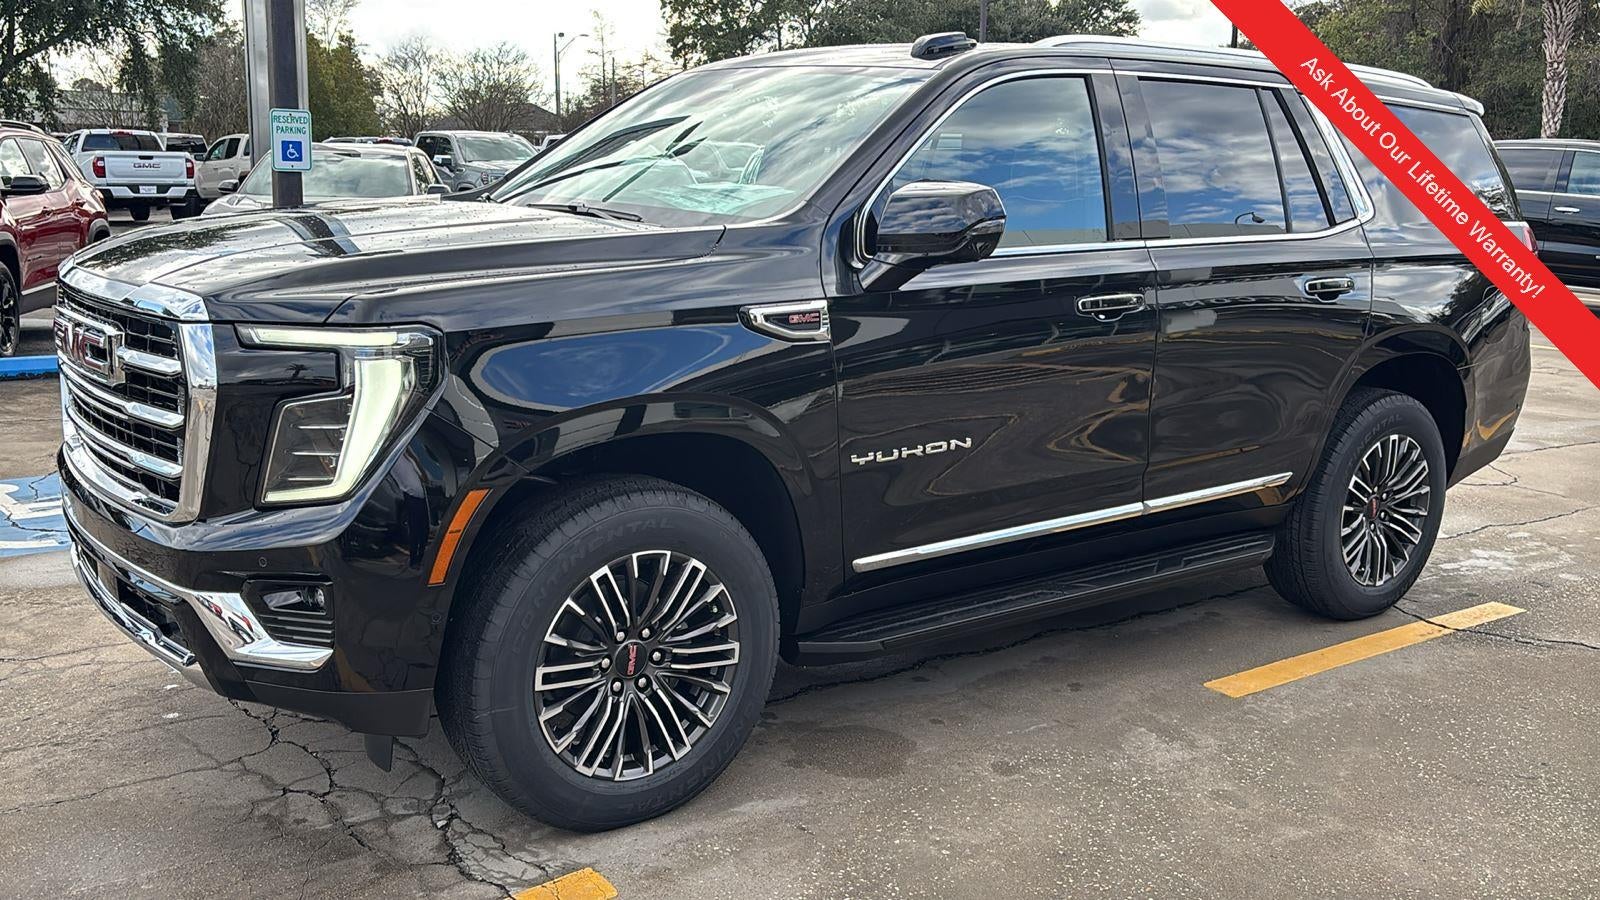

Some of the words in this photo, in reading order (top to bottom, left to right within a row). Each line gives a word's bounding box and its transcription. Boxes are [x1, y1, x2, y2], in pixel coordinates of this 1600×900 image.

[273, 115, 308, 125] RESERVED
[276, 125, 307, 135] PARKING
[789, 312, 820, 324] GMC
[851, 437, 972, 465] YUKON
